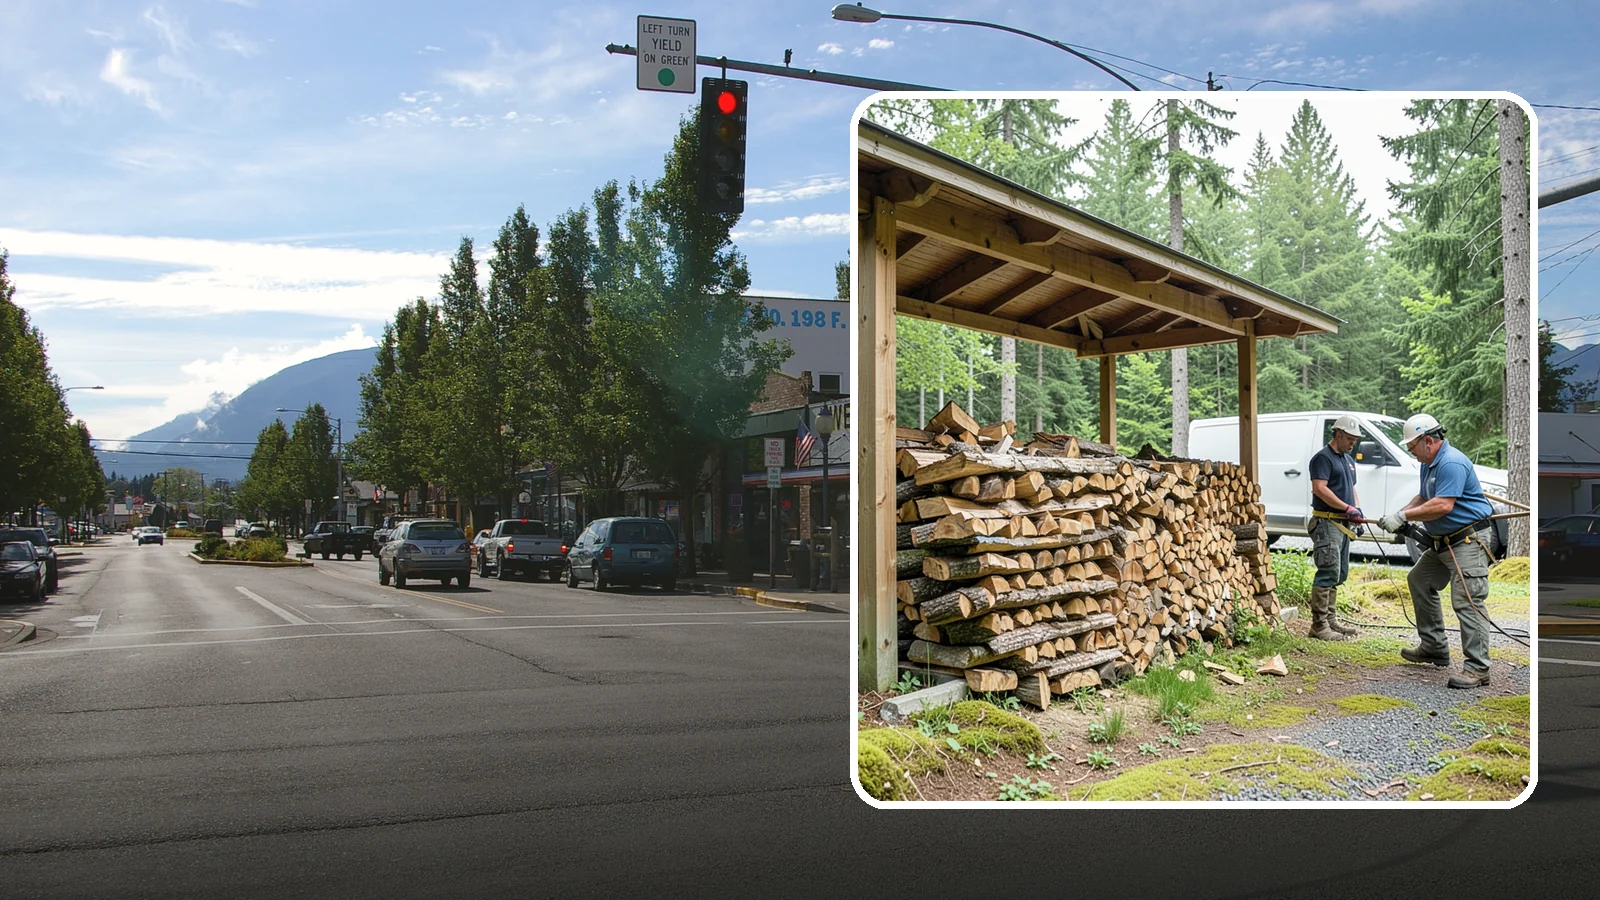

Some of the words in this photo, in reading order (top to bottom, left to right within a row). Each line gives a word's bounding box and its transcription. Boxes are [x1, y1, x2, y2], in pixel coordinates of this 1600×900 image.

[643, 23, 663, 34] LEFT
[668, 26, 690, 37] TURN
[652, 38, 682, 52] YIELD
[644, 53, 656, 63] ON
[661, 55, 689, 66] GREEN
[791, 309, 826, 328] 198
[831, 311, 847, 329] F.
